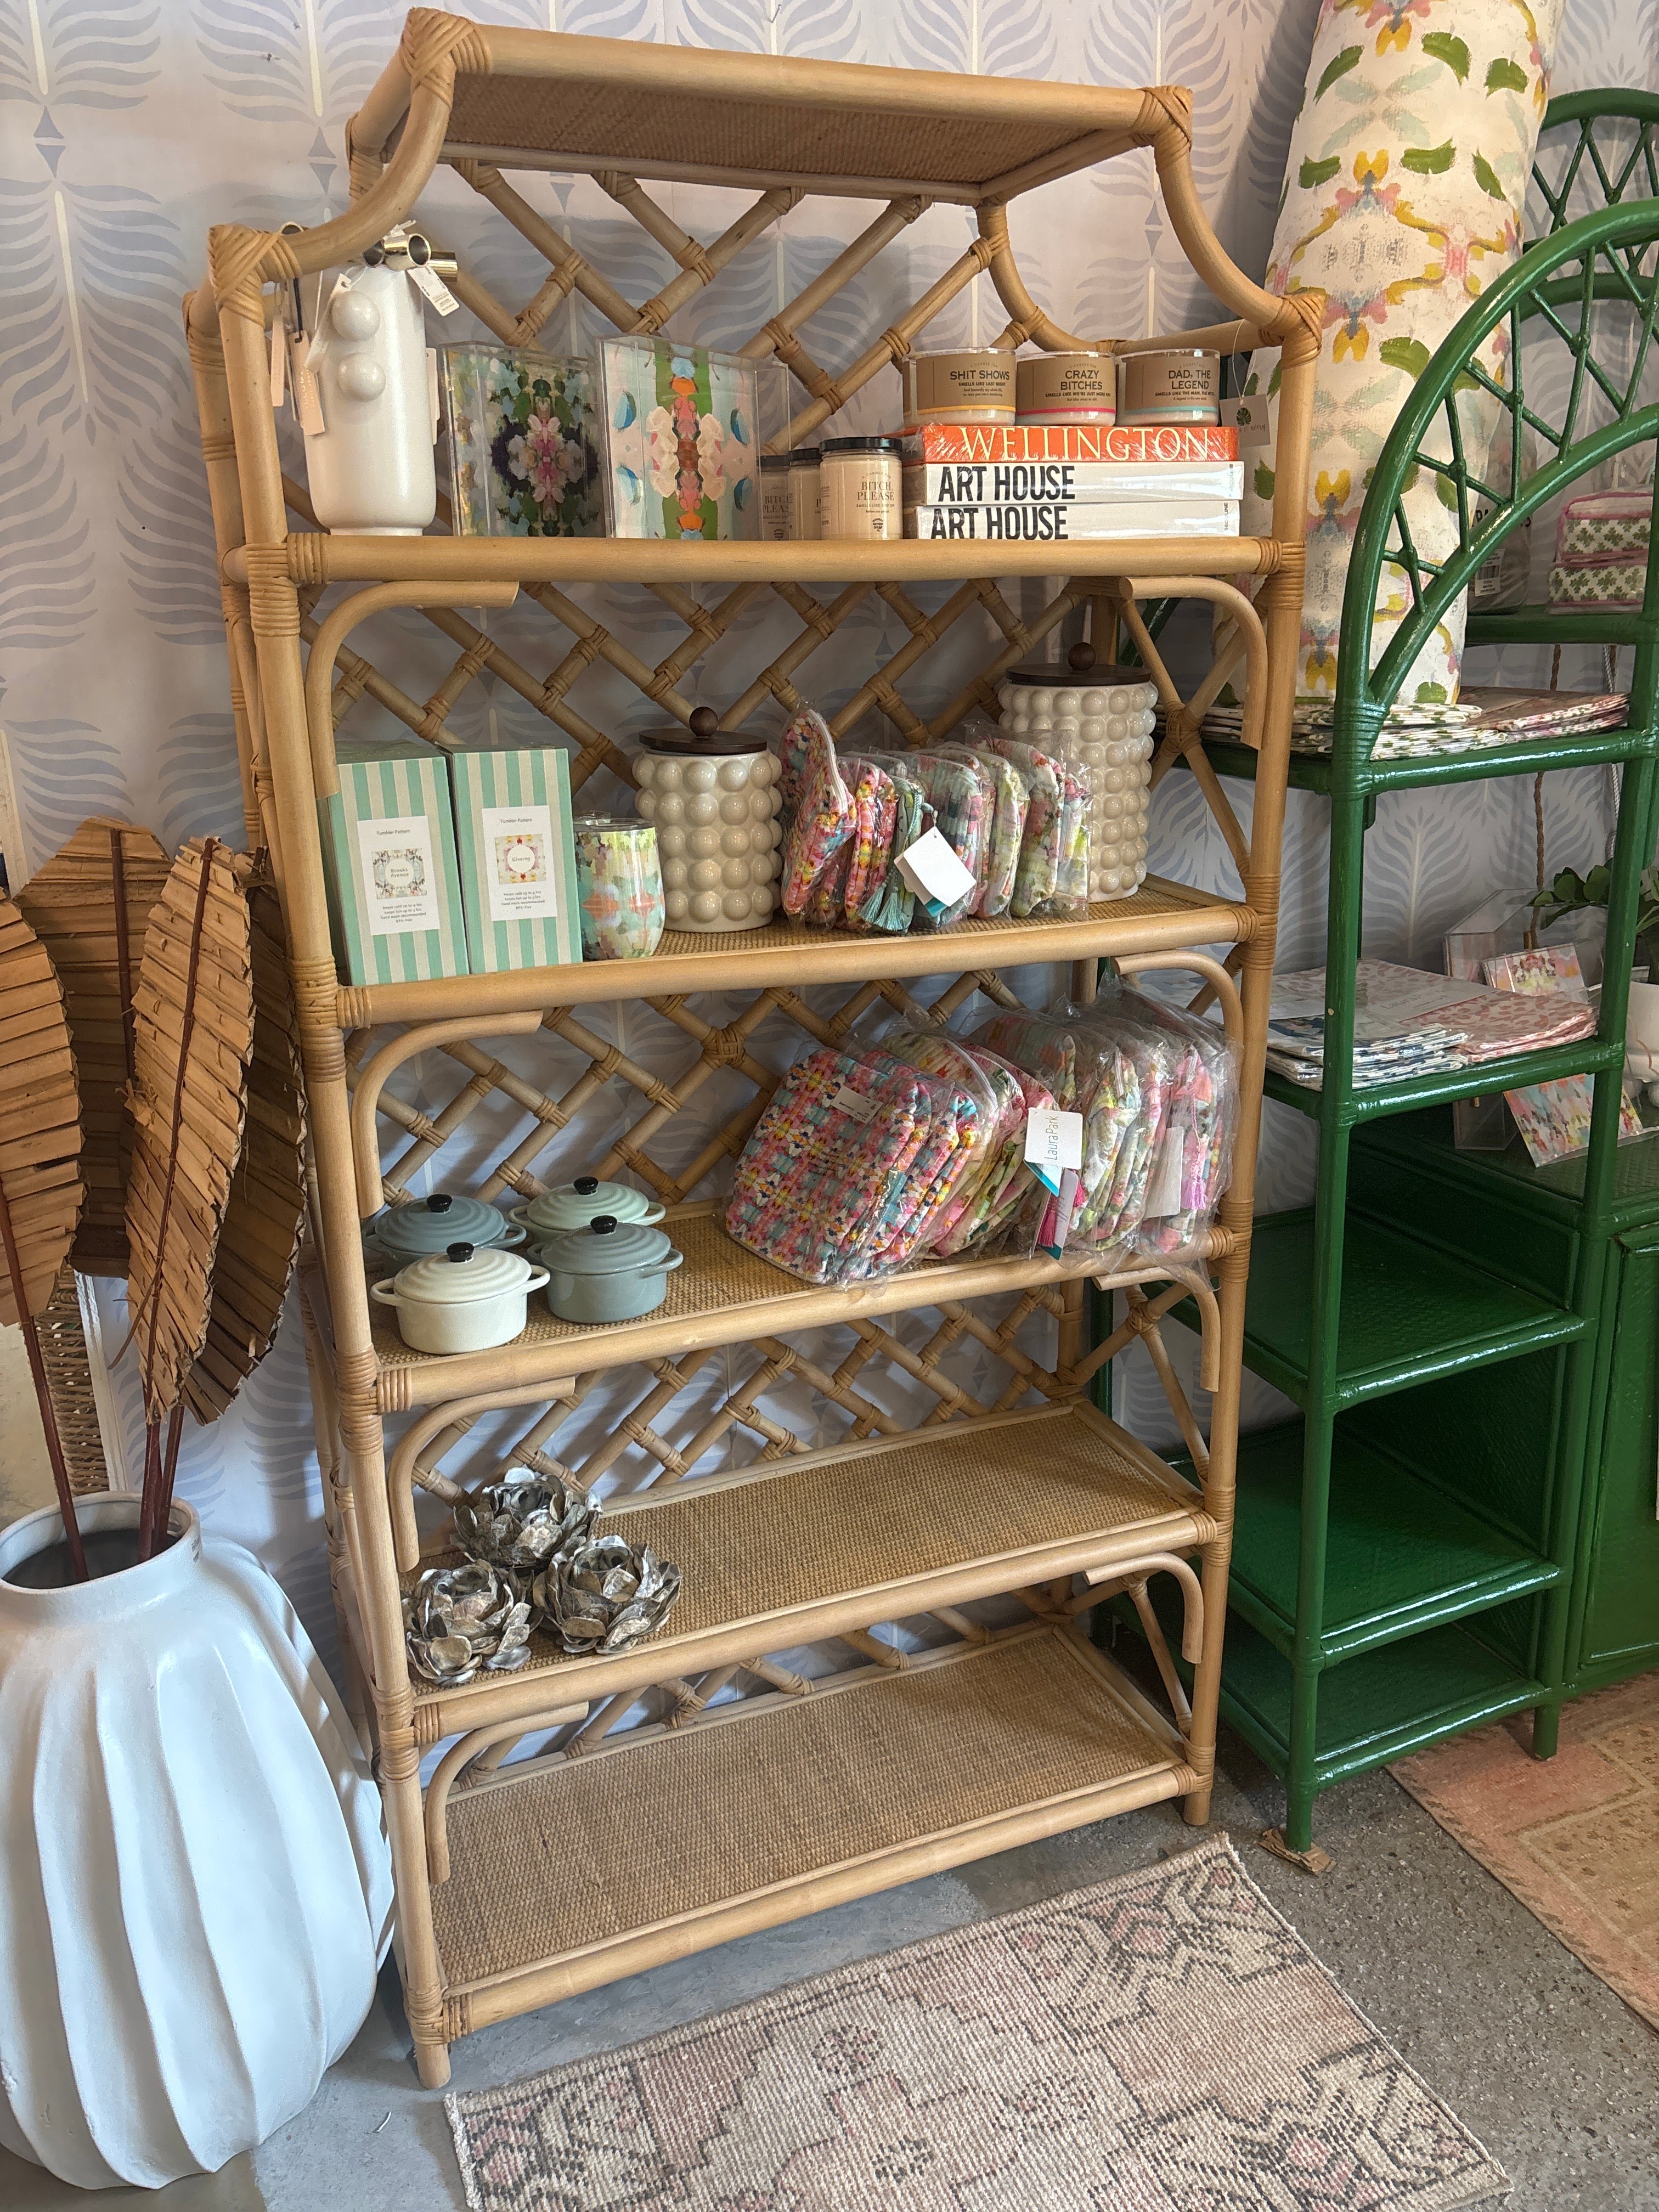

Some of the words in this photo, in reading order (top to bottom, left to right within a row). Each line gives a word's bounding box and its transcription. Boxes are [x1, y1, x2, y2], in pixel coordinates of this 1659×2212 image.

[950, 370, 977, 380] SHIT
[979, 370, 1010, 380] SHOWS
[1065, 370, 1099, 379] CRAZY
[1168, 370, 1193, 379] DAD,
[1196, 370, 1211, 379] THE
[1060, 381, 1103, 390] BITCHES
[1171, 380, 1209, 390] LEGEND
[960, 427, 1209, 460] WELLINGTON
[938, 466, 987, 502] ART
[994, 465, 1076, 501] HOUSE
[857, 492, 895, 500] PLEASE
[930, 506, 979, 540] ART
[985, 506, 1069, 540] HOUSE
